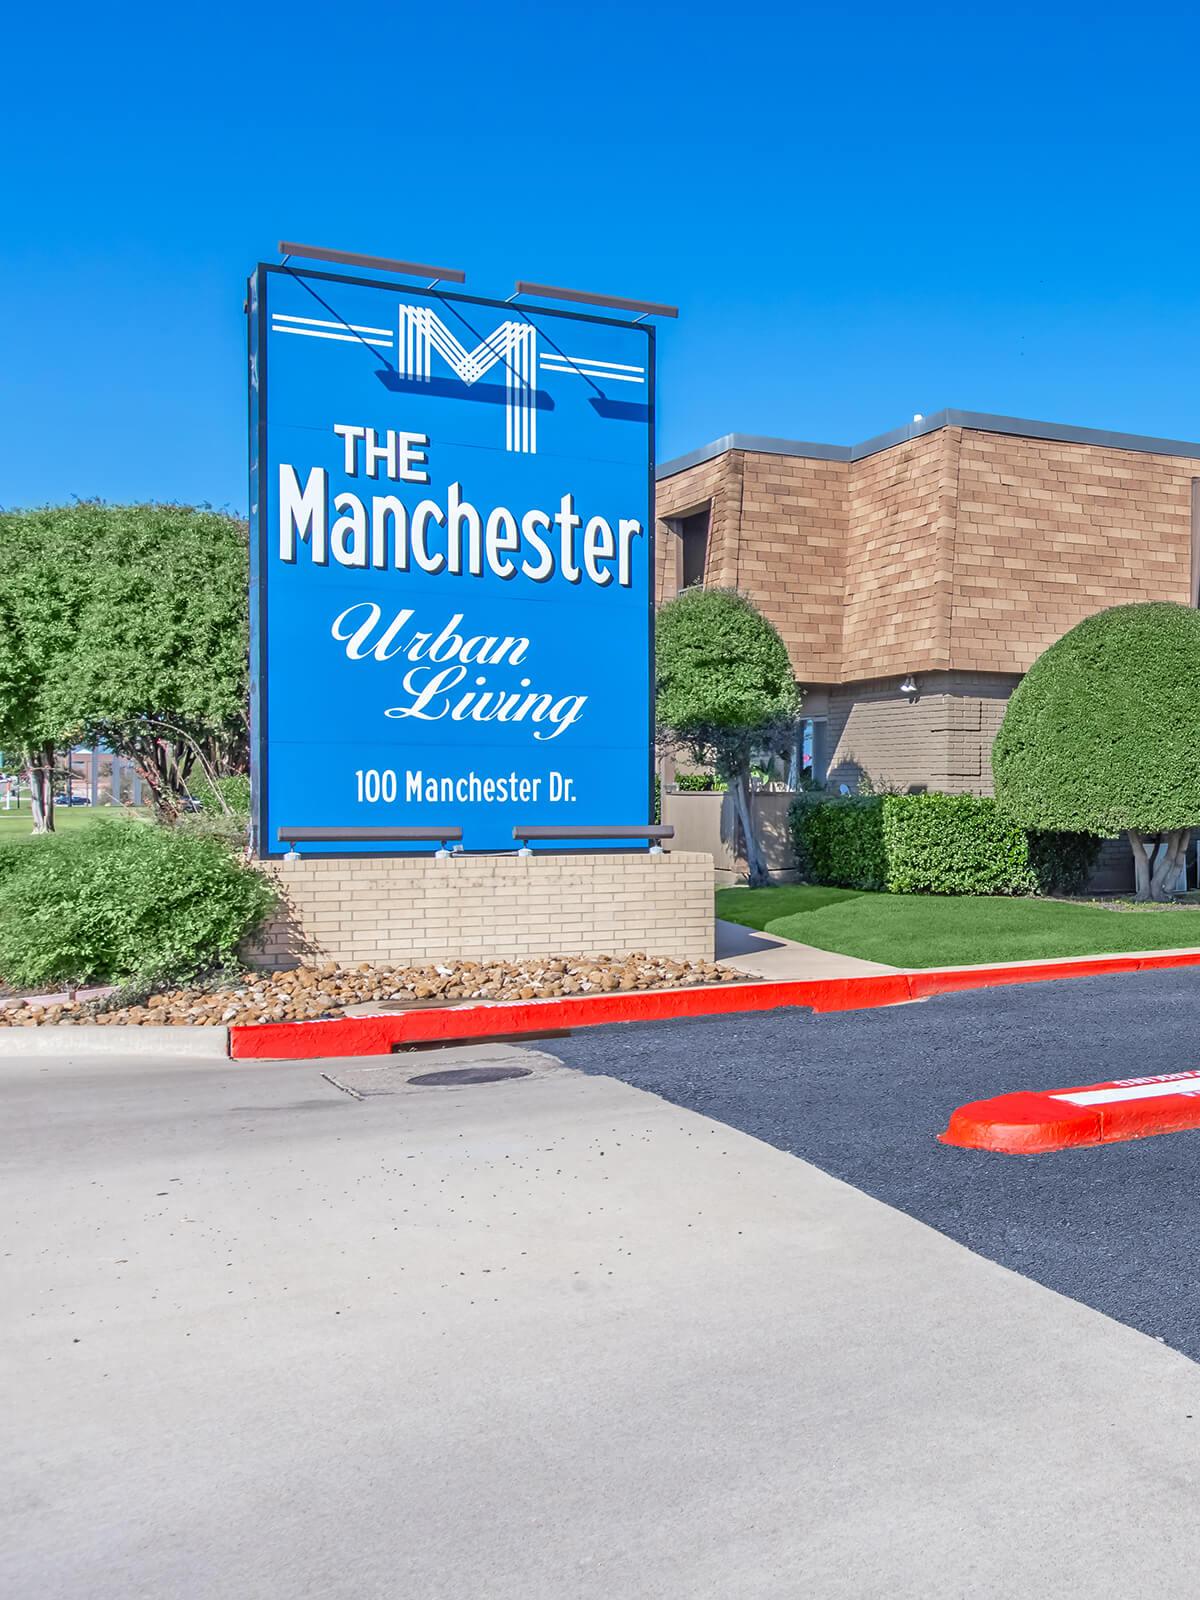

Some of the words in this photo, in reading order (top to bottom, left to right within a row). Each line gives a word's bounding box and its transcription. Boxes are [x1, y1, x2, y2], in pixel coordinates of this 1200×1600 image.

[334, 424, 429, 482] THE
[279, 463, 643, 587] Manchester
[331, 602, 530, 666] Urban
[384, 665, 587, 740] Living
[355, 769, 397, 803] 100
[406, 770, 542, 802] Manchester
[549, 771, 577, 802] Dr.
